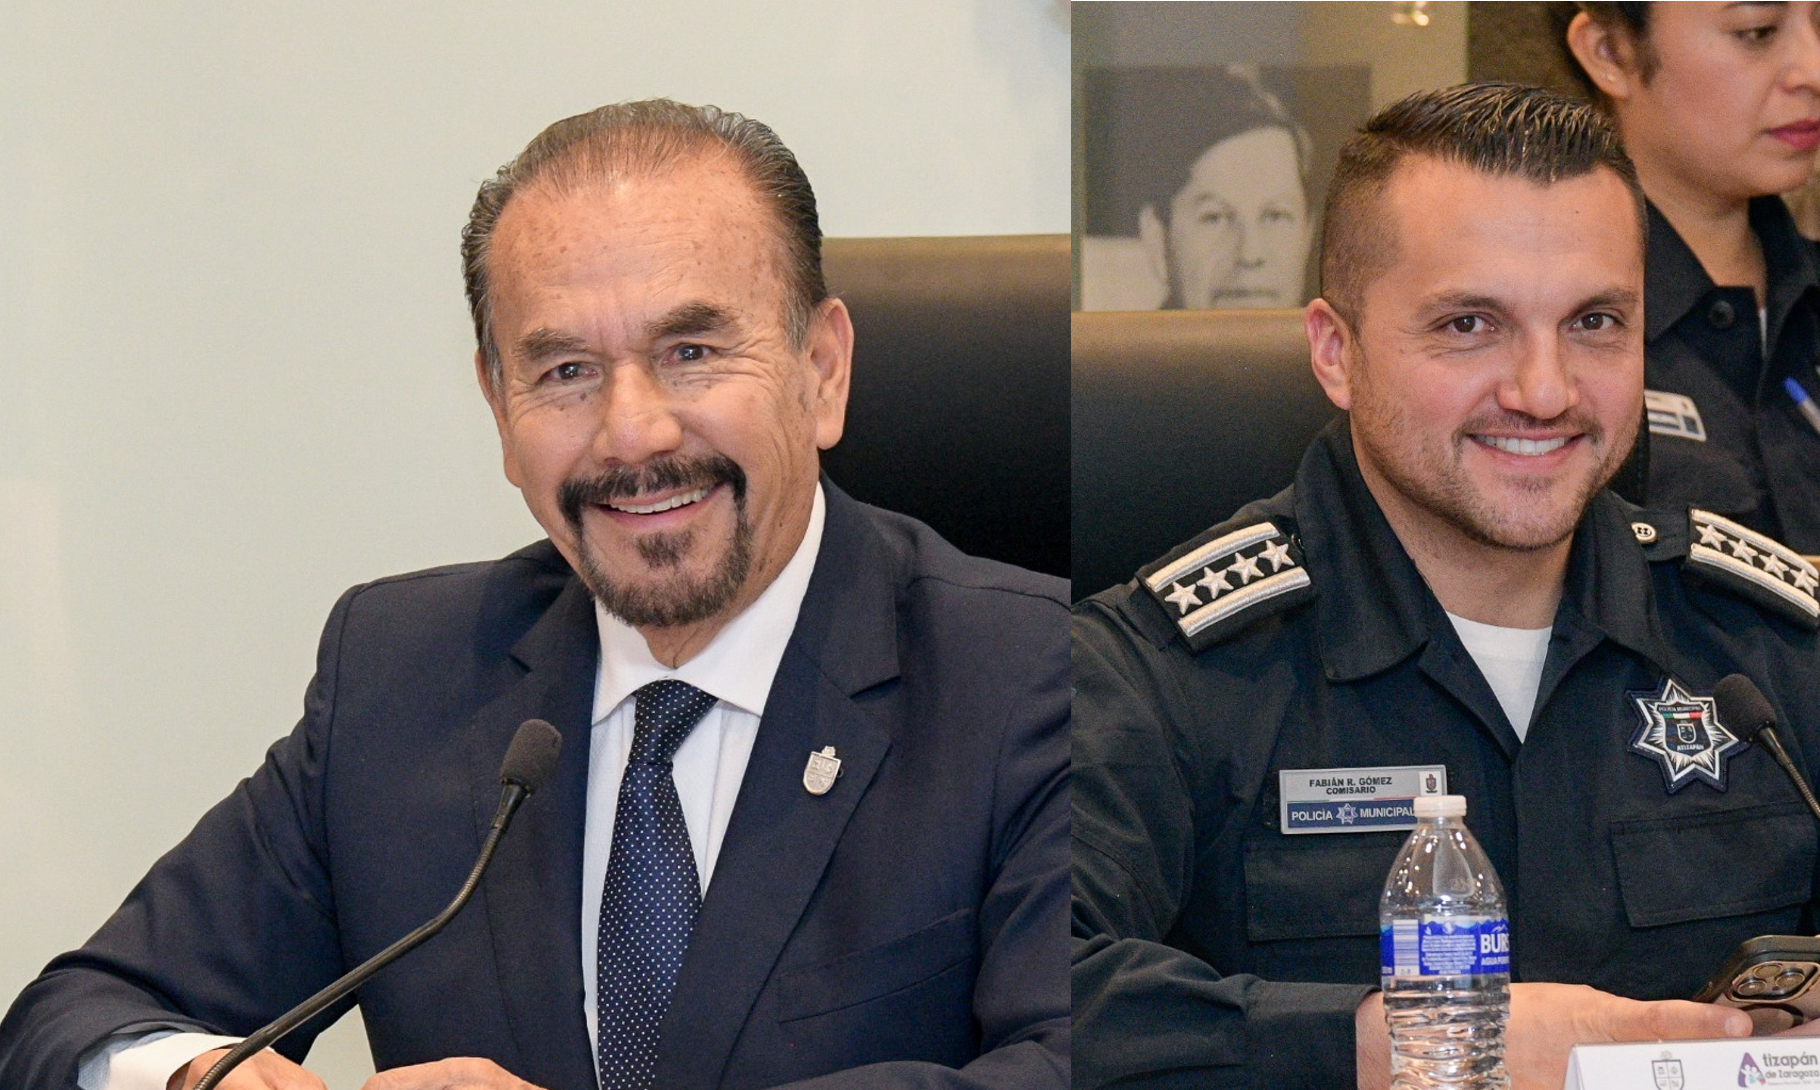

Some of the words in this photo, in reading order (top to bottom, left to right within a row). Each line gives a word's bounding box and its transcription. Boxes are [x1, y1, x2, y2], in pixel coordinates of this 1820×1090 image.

[1309, 776, 1344, 787] FABIÁN
[1347, 778, 1356, 786] R.
[1358, 775, 1392, 785] GÓMEZ
[1326, 786, 1376, 795] COMISARIO
[1291, 808, 1333, 821] POLICÍA
[1360, 806, 1414, 818] MUNICIPAL
[1480, 932, 1509, 953] BUR
[1765, 1071, 1777, 1079] de
[1779, 1070, 1820, 1080] Zaragoza
